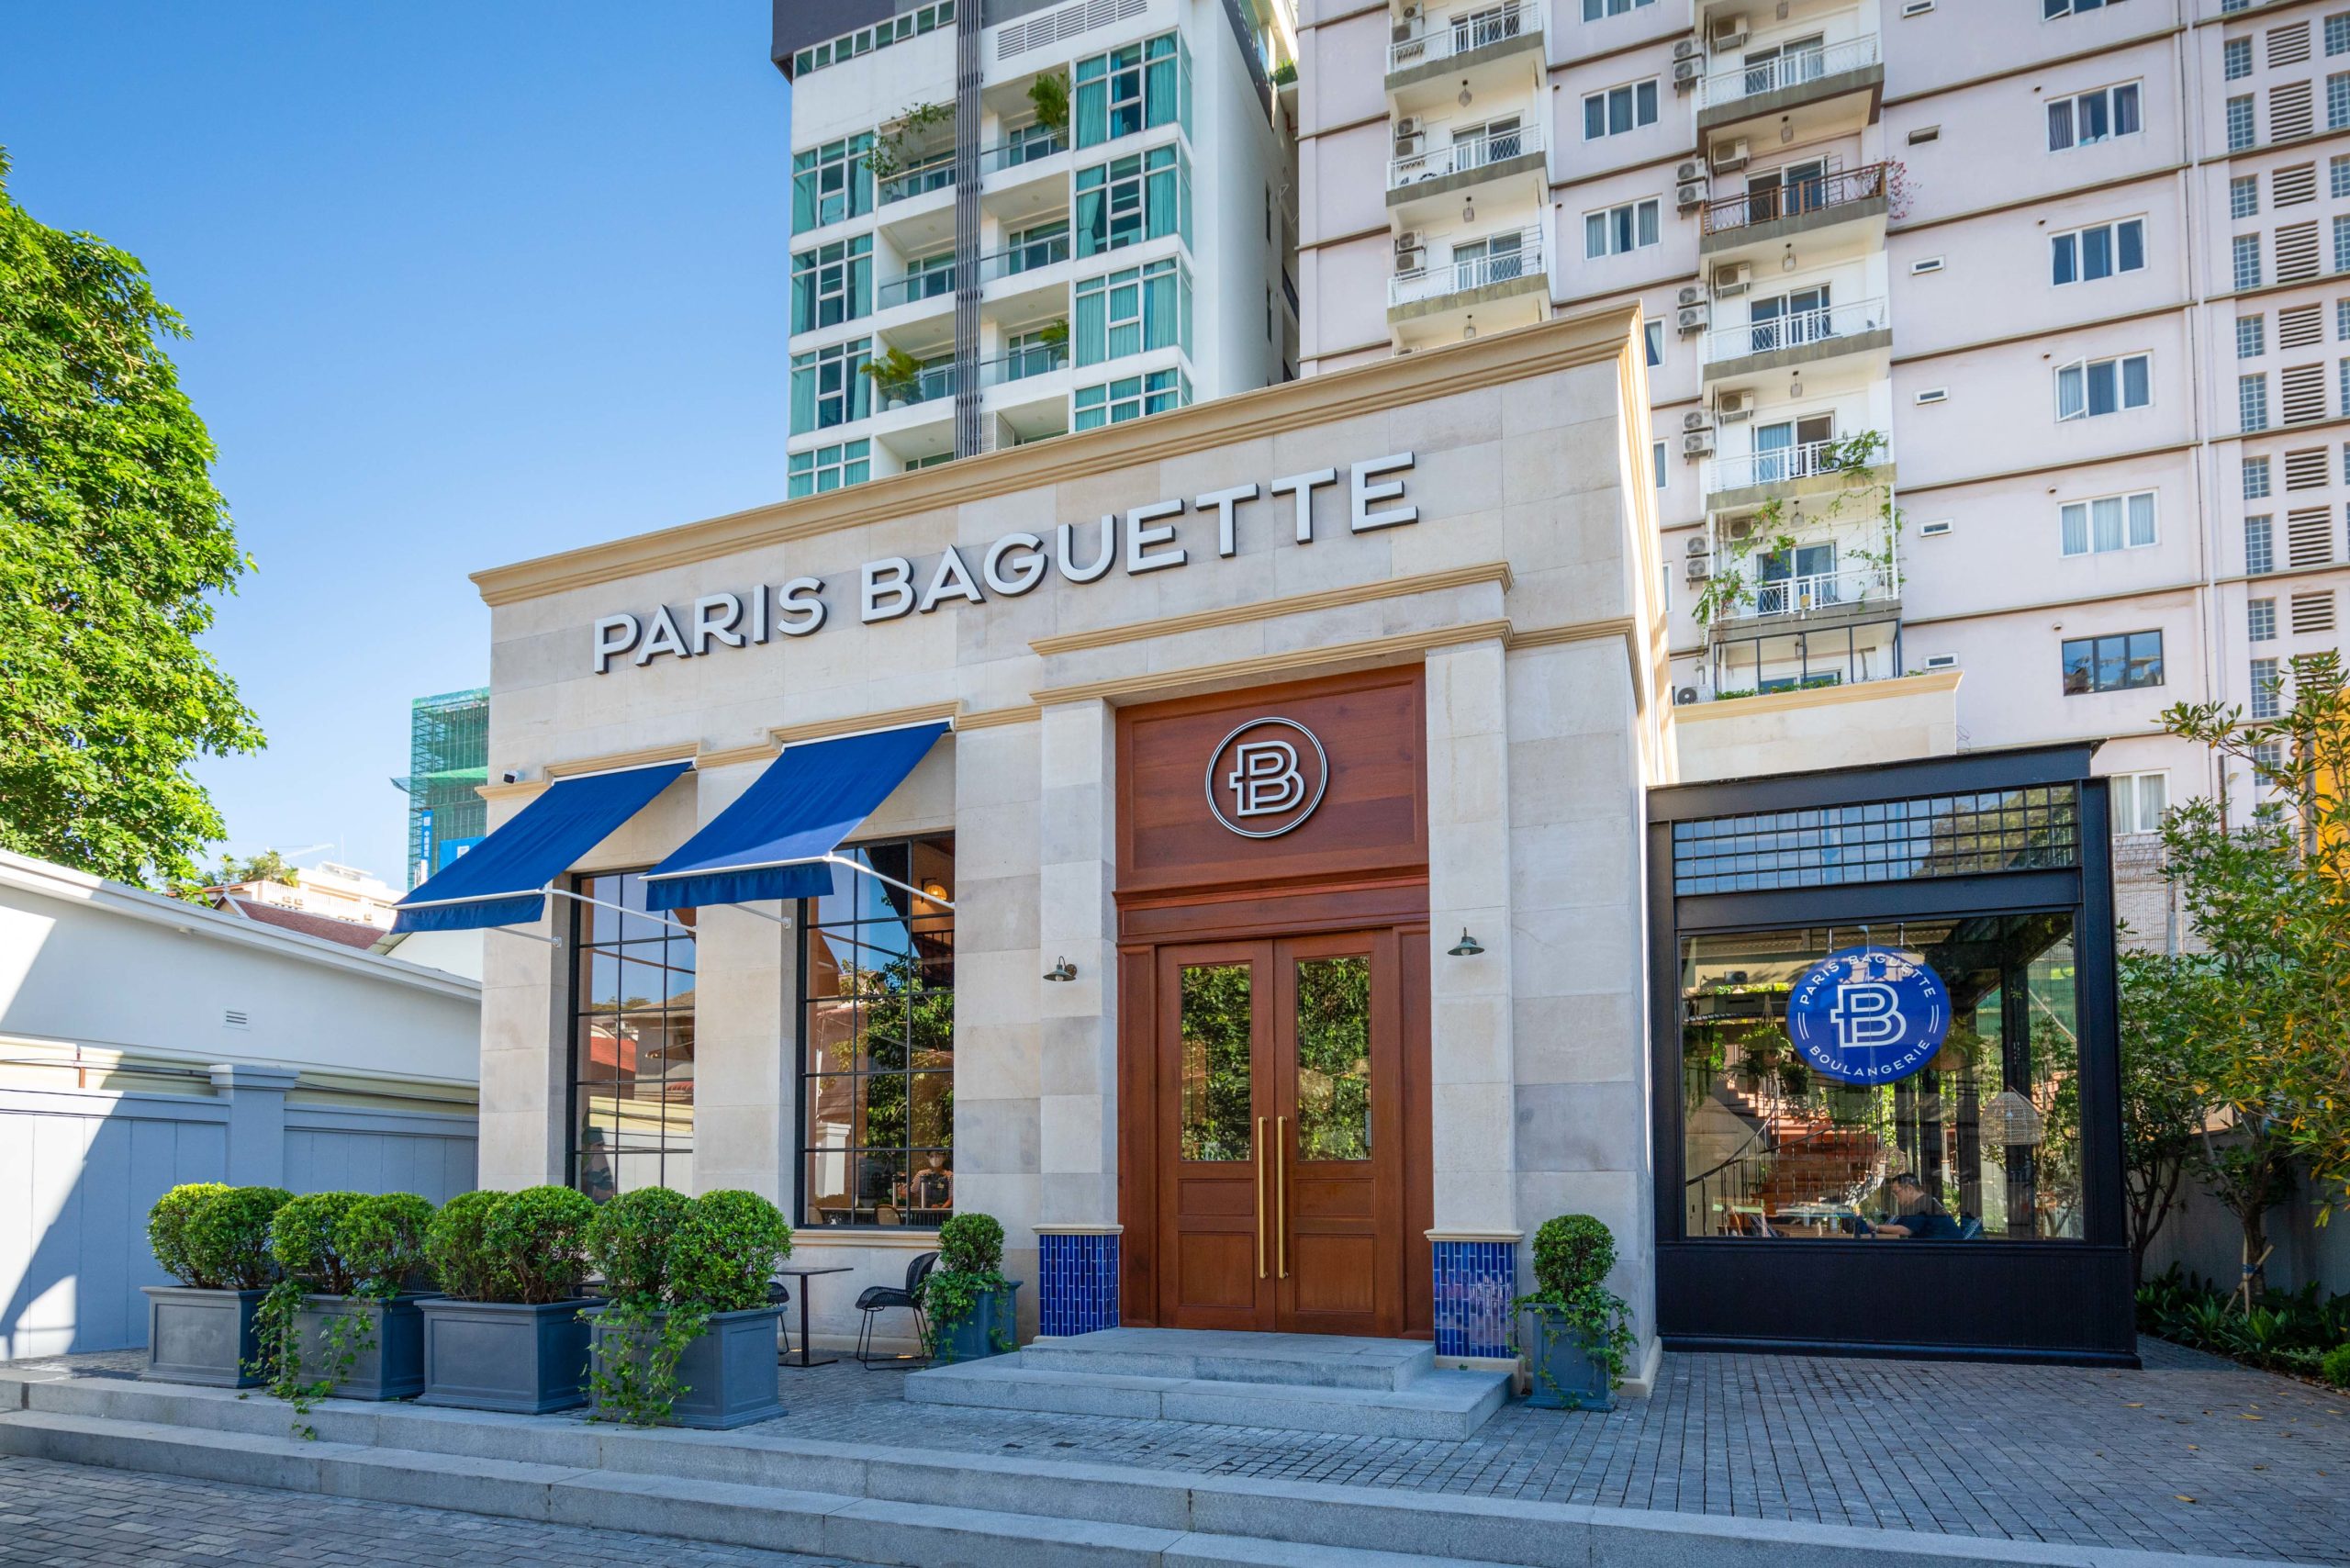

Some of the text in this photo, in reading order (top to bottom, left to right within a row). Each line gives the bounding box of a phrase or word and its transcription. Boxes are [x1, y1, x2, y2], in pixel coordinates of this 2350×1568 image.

[595, 451, 1418, 674] PARIS BAGUETTE
[1800, 953, 1936, 1004] PARIS BAGUETTE
[1809, 1039, 1930, 1077] BOULANGERIE
